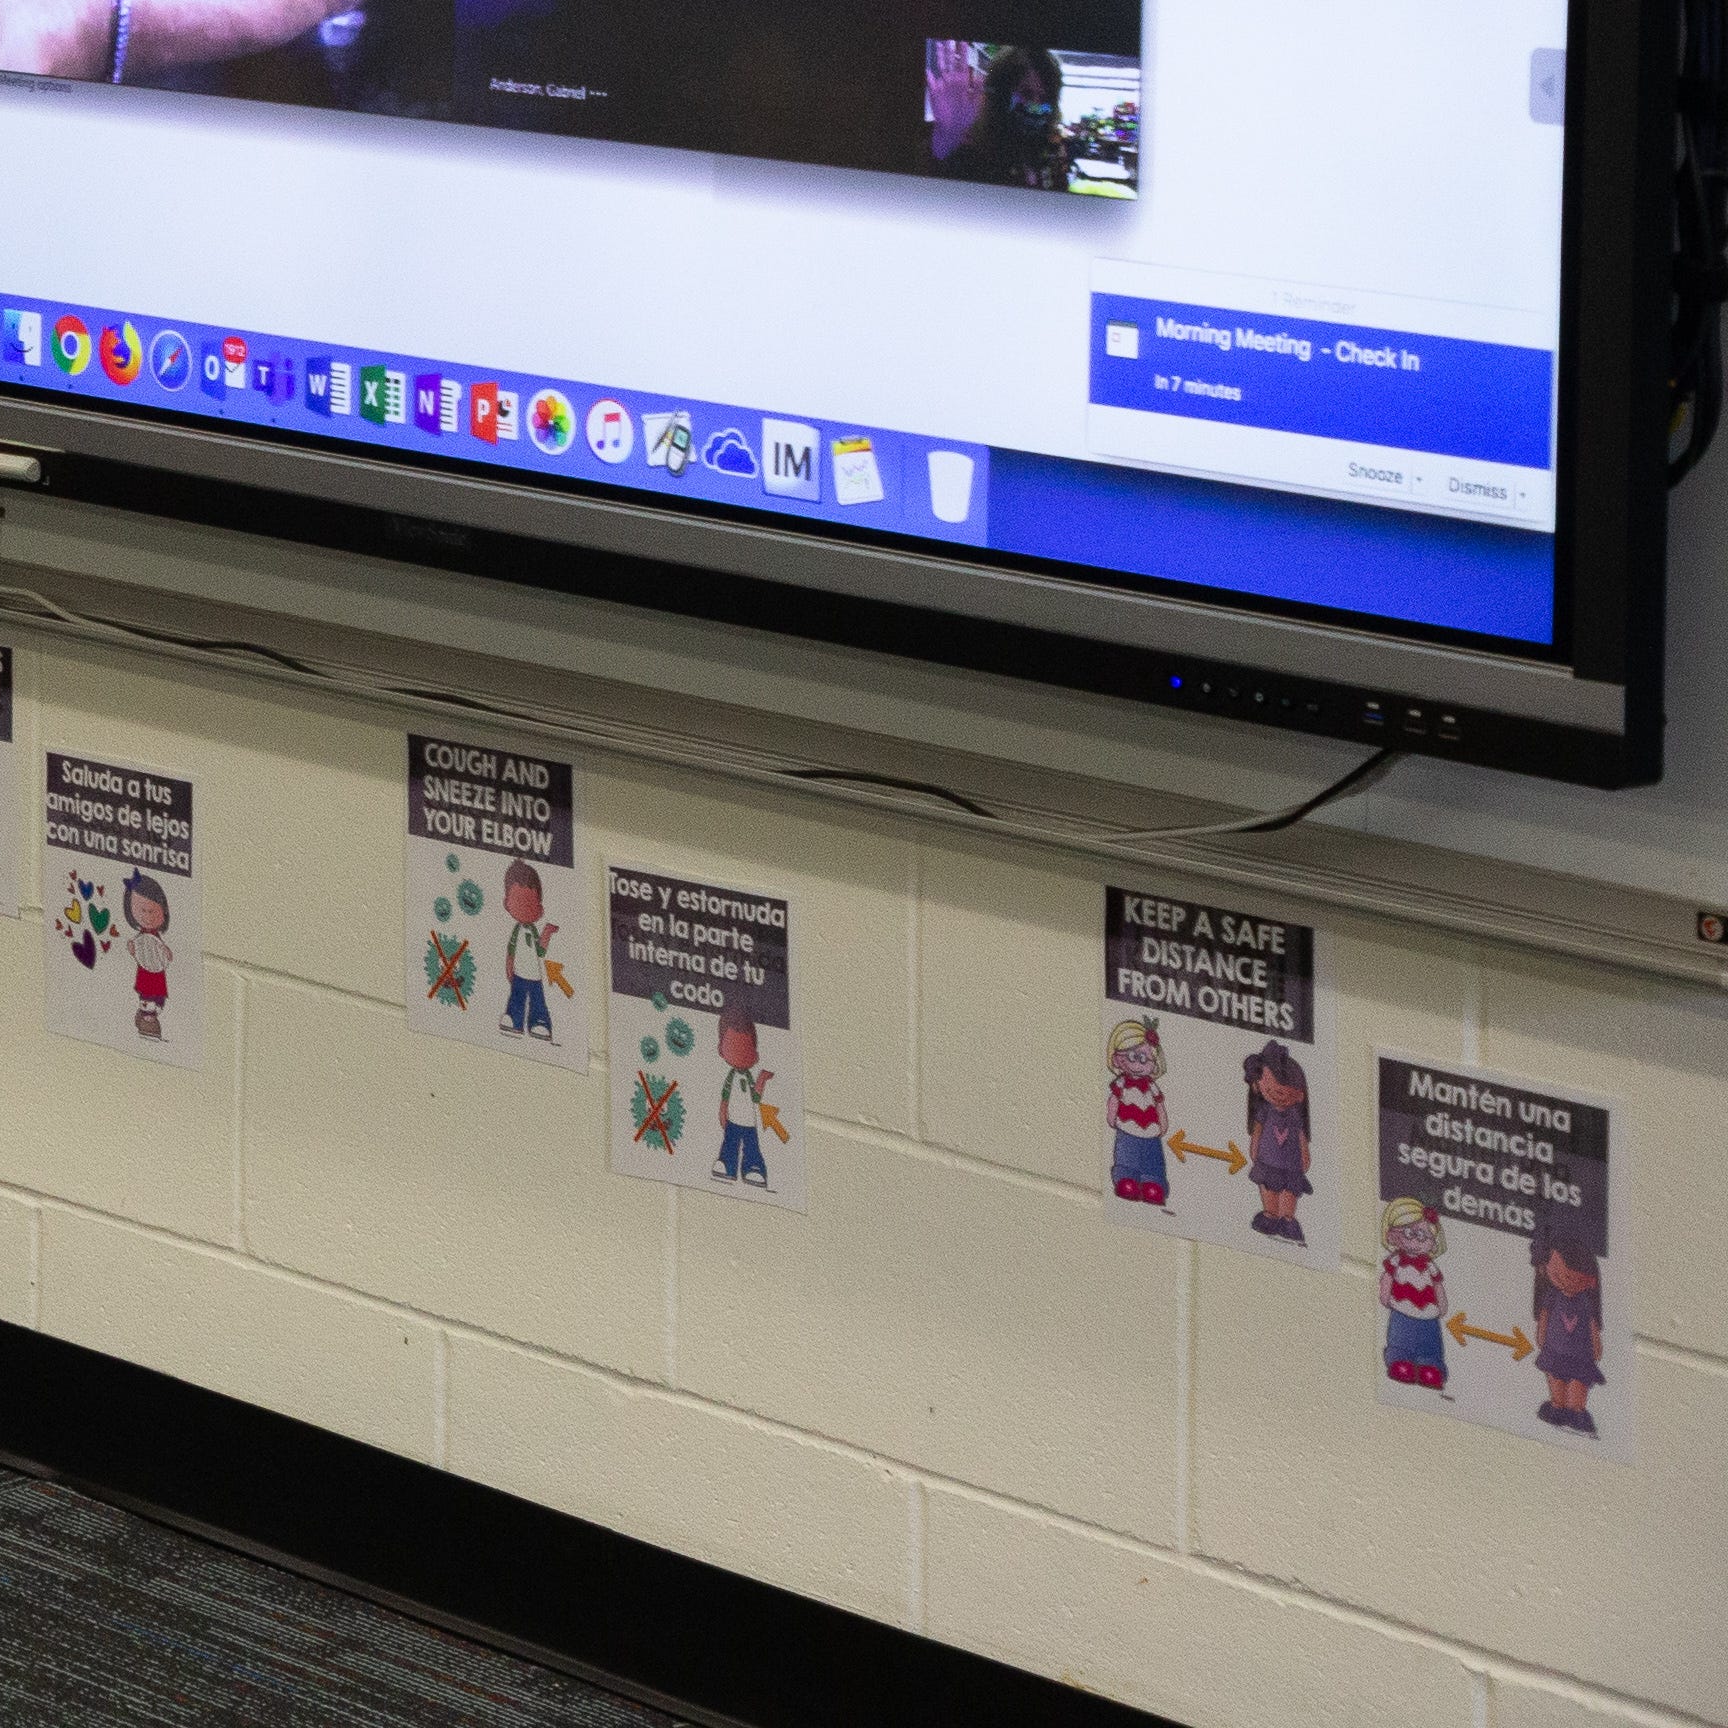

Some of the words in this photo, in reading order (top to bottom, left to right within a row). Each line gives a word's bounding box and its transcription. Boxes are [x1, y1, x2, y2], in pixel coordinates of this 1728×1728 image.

[1156, 317, 1231, 352] Morning
[1235, 327, 1311, 362] Meeting
[1335, 338, 1395, 367] Check
[1401, 348, 1420, 371] In
[1154, 375, 1169, 391] In
[1170, 378, 1181, 391] 7
[1182, 378, 1241, 401] minutes
[1348, 461, 1403, 485] Snooze
[1448, 474, 1508, 501] Dismiss
[61, 761, 123, 794] Saluda
[128, 781, 140, 795] a
[144, 777, 172, 803] tus
[424, 744, 496, 775] COUGH
[501, 760, 549, 789] AND
[48, 791, 113, 824] amigos
[118, 802, 140, 825] de
[146, 804, 189, 839] lejos
[423, 777, 495, 810] SNEEZE
[501, 791, 550, 821] INTO
[48, 819, 79, 843] con
[84, 829, 117, 853] una
[122, 834, 190, 870] sonrisa
[424, 808, 476, 840] YOUR
[481, 818, 552, 854] ELBOW
[1125, 897, 1185, 931] KEEP
[1193, 912, 1214, 938] A
[1221, 917, 1286, 953] SAFE
[1142, 938, 1268, 988] DISTANCE
[1117, 969, 1190, 1008] FROM
[1197, 986, 1293, 1030] OTHERS
[1410, 1071, 1512, 1118] Mantén
[1519, 1099, 1571, 1131] una
[1425, 1111, 1553, 1162] distancia
[1397, 1143, 1495, 1186] segura
[1502, 1162, 1536, 1192] de
[1542, 1170, 1581, 1205] los
[1443, 1185, 1535, 1229] demás
